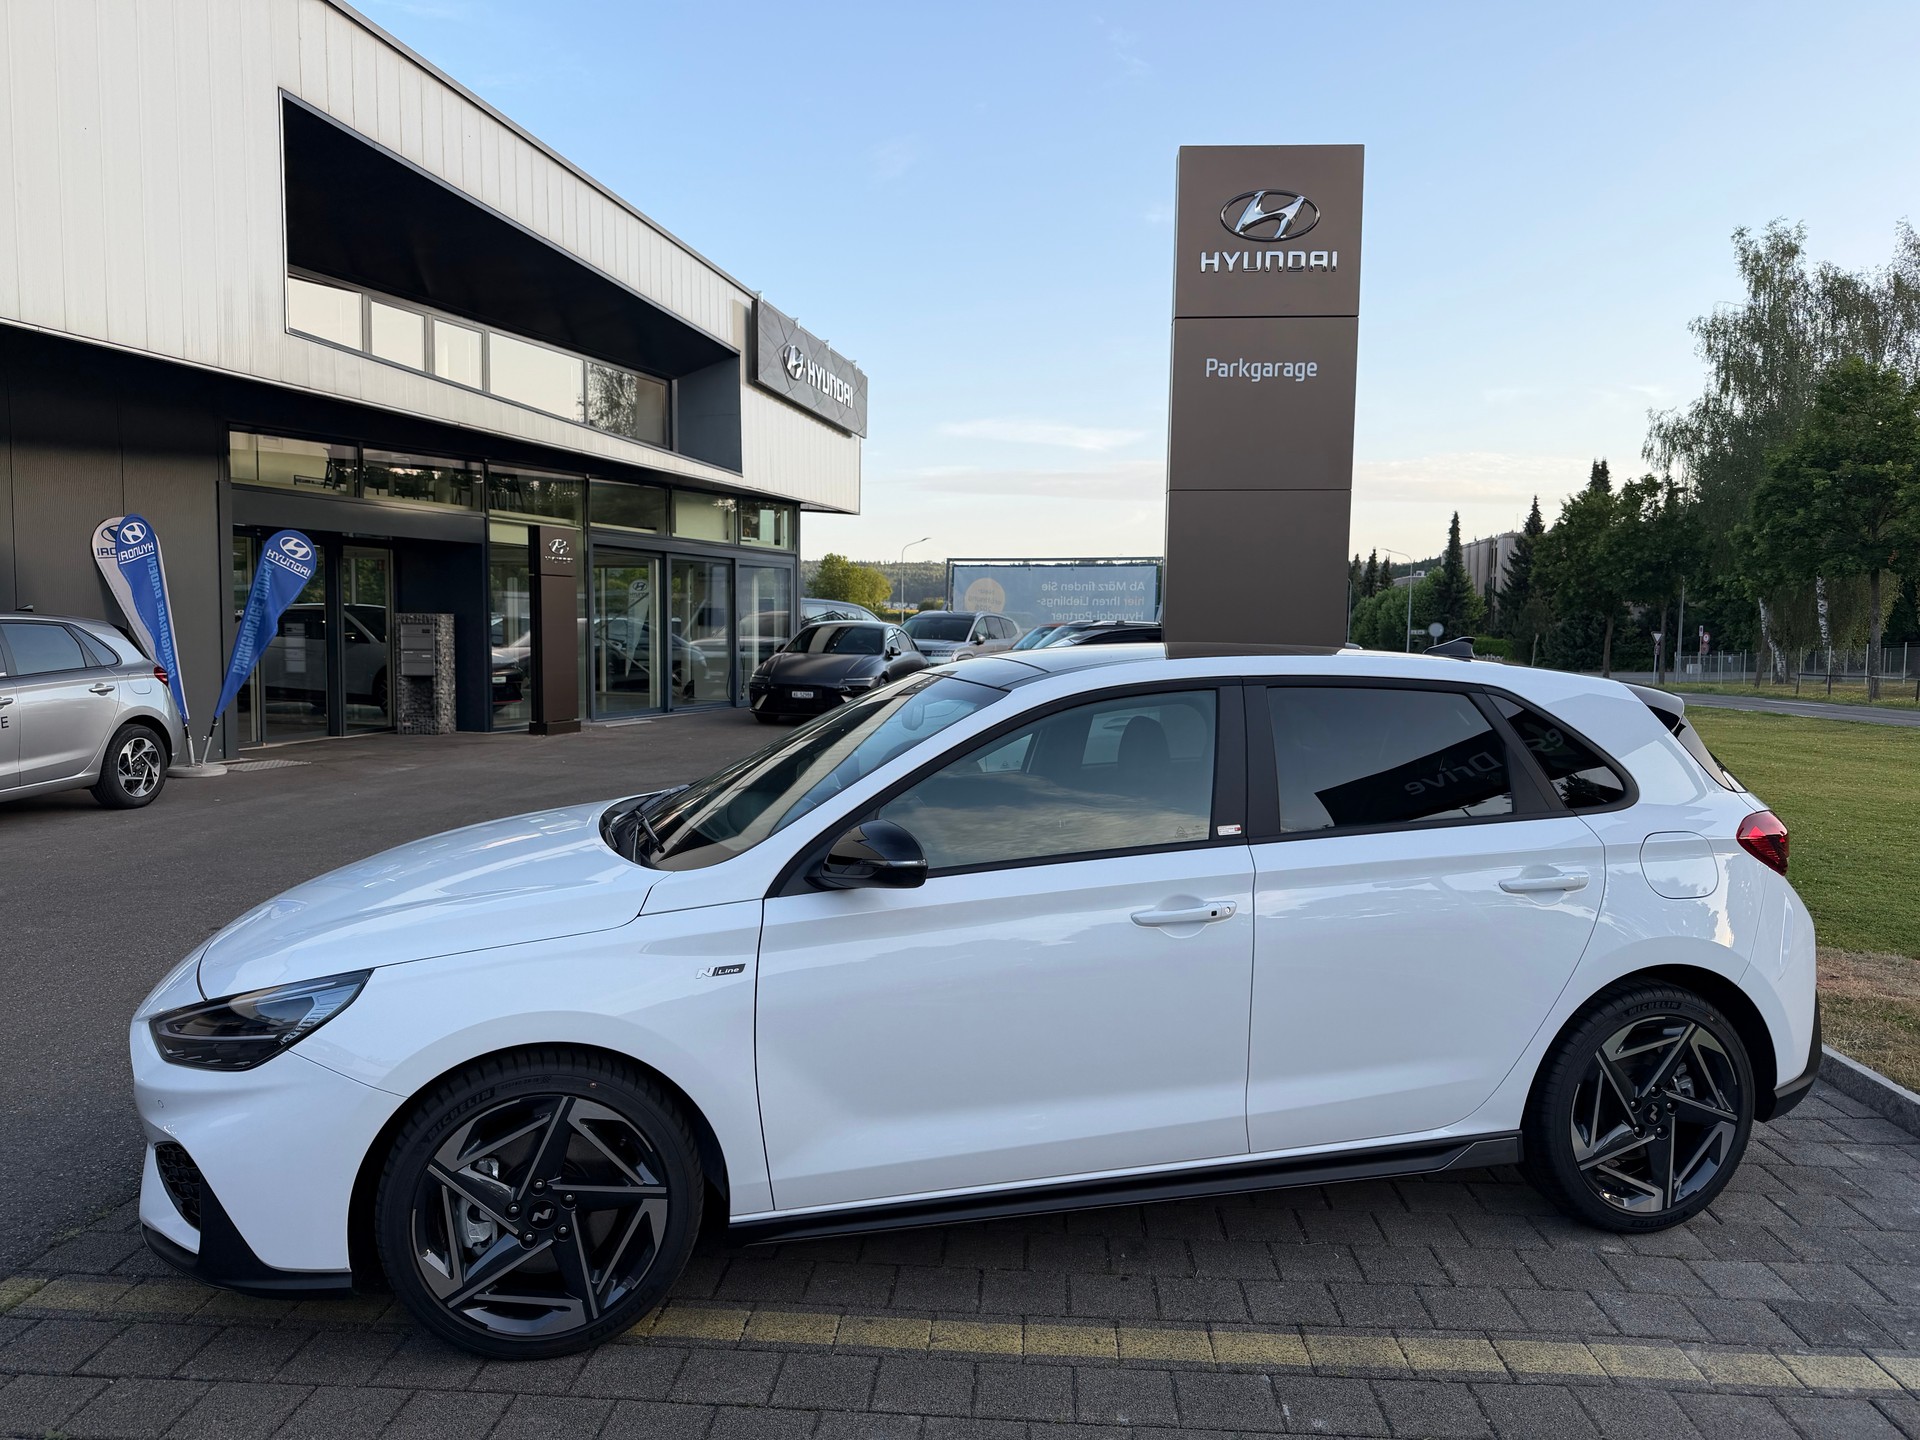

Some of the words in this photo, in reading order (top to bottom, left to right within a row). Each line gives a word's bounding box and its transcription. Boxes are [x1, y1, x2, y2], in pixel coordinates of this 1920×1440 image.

[1200, 251, 1338, 273] HYUNDAI
[807, 359, 853, 409] HYUNDAI
[1205, 358, 1318, 382] Parkgarage
[266, 549, 312, 577] HYUNDAI
[232, 601, 265, 676] PARKGARAGE
[1628, 1002, 1679, 1015] MICHELIN
[428, 1089, 492, 1140] MICHELIN
